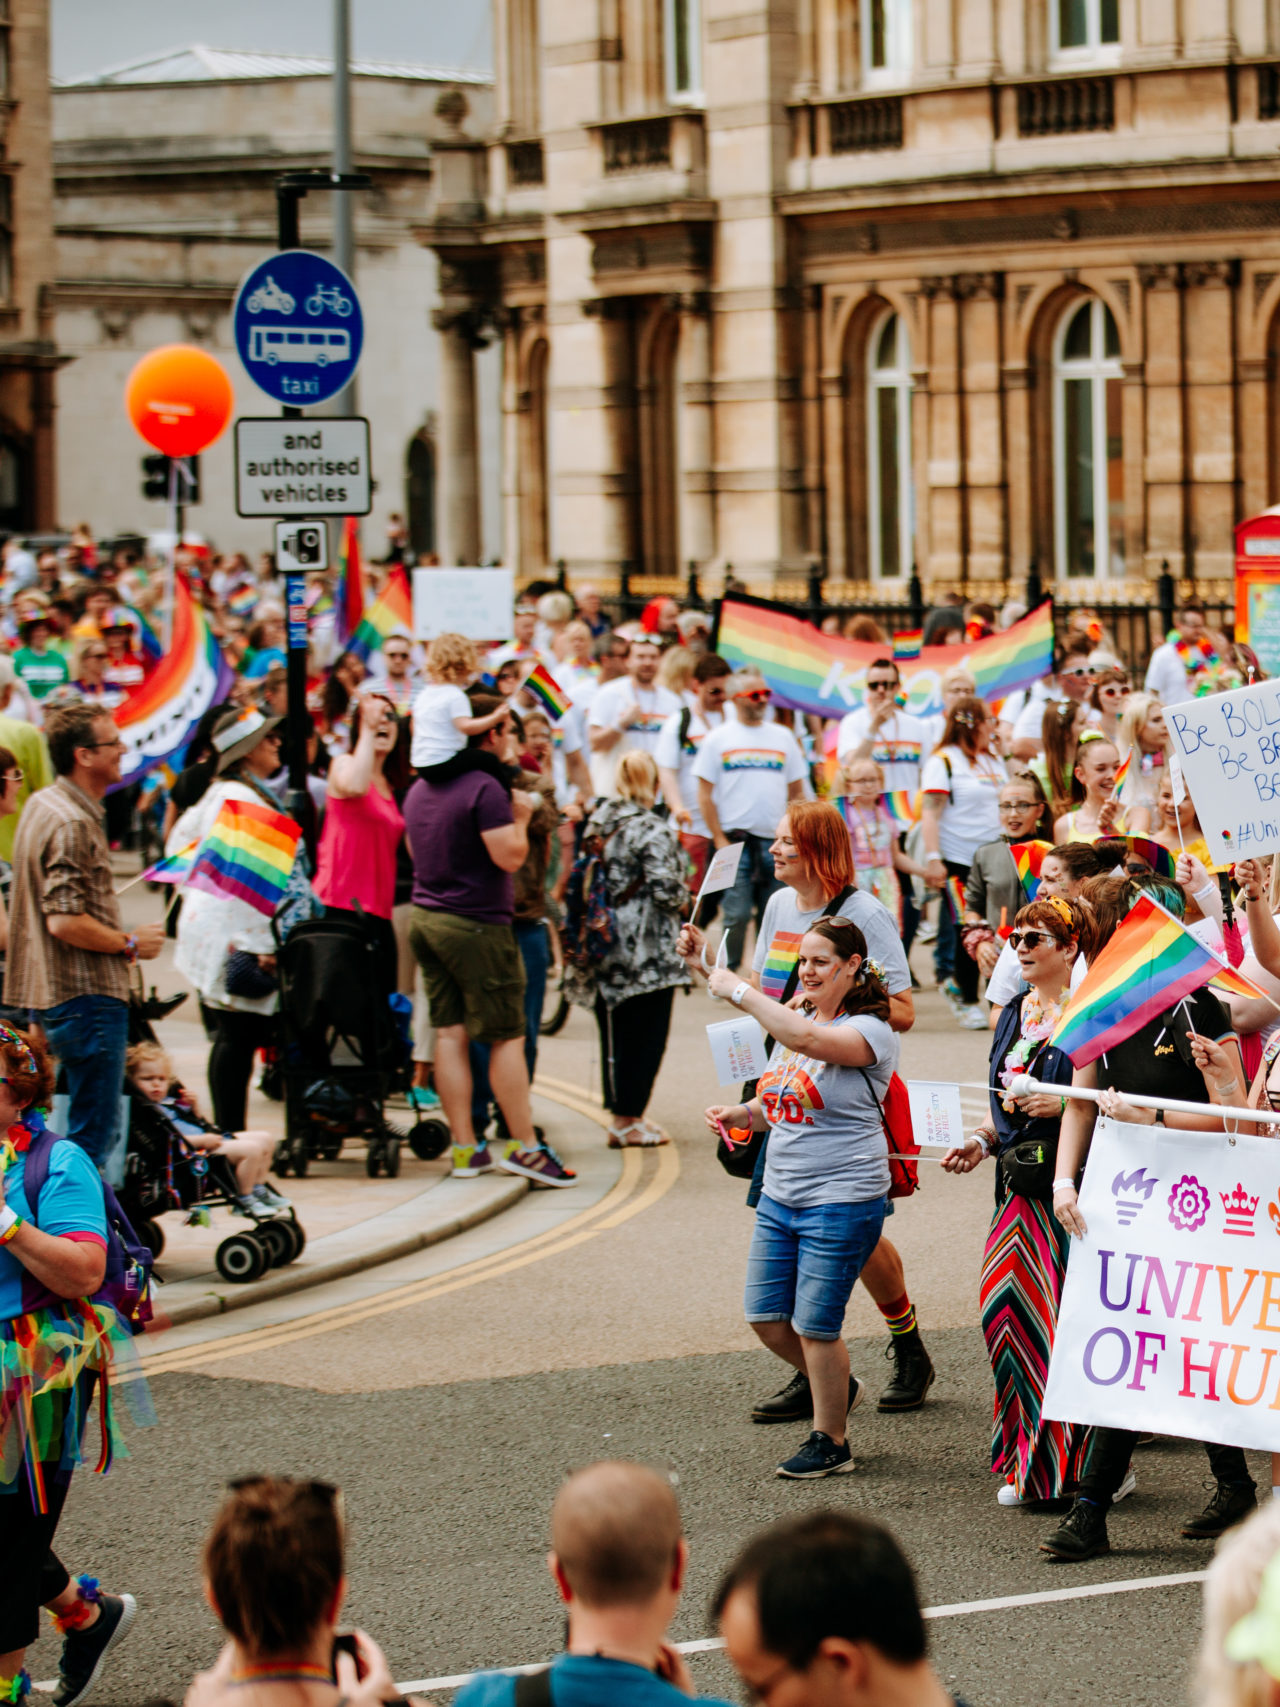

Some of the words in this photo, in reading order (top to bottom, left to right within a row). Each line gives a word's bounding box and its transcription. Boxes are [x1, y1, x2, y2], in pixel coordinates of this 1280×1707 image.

[282, 376, 320, 395] taxi
[284, 431, 322, 450] and
[247, 457, 359, 476] authorised
[261, 484, 348, 503] vehicles
[1172, 713, 1215, 755] Be
[1218, 744, 1255, 780] Be
[1082, 1326, 1166, 1391] OF
